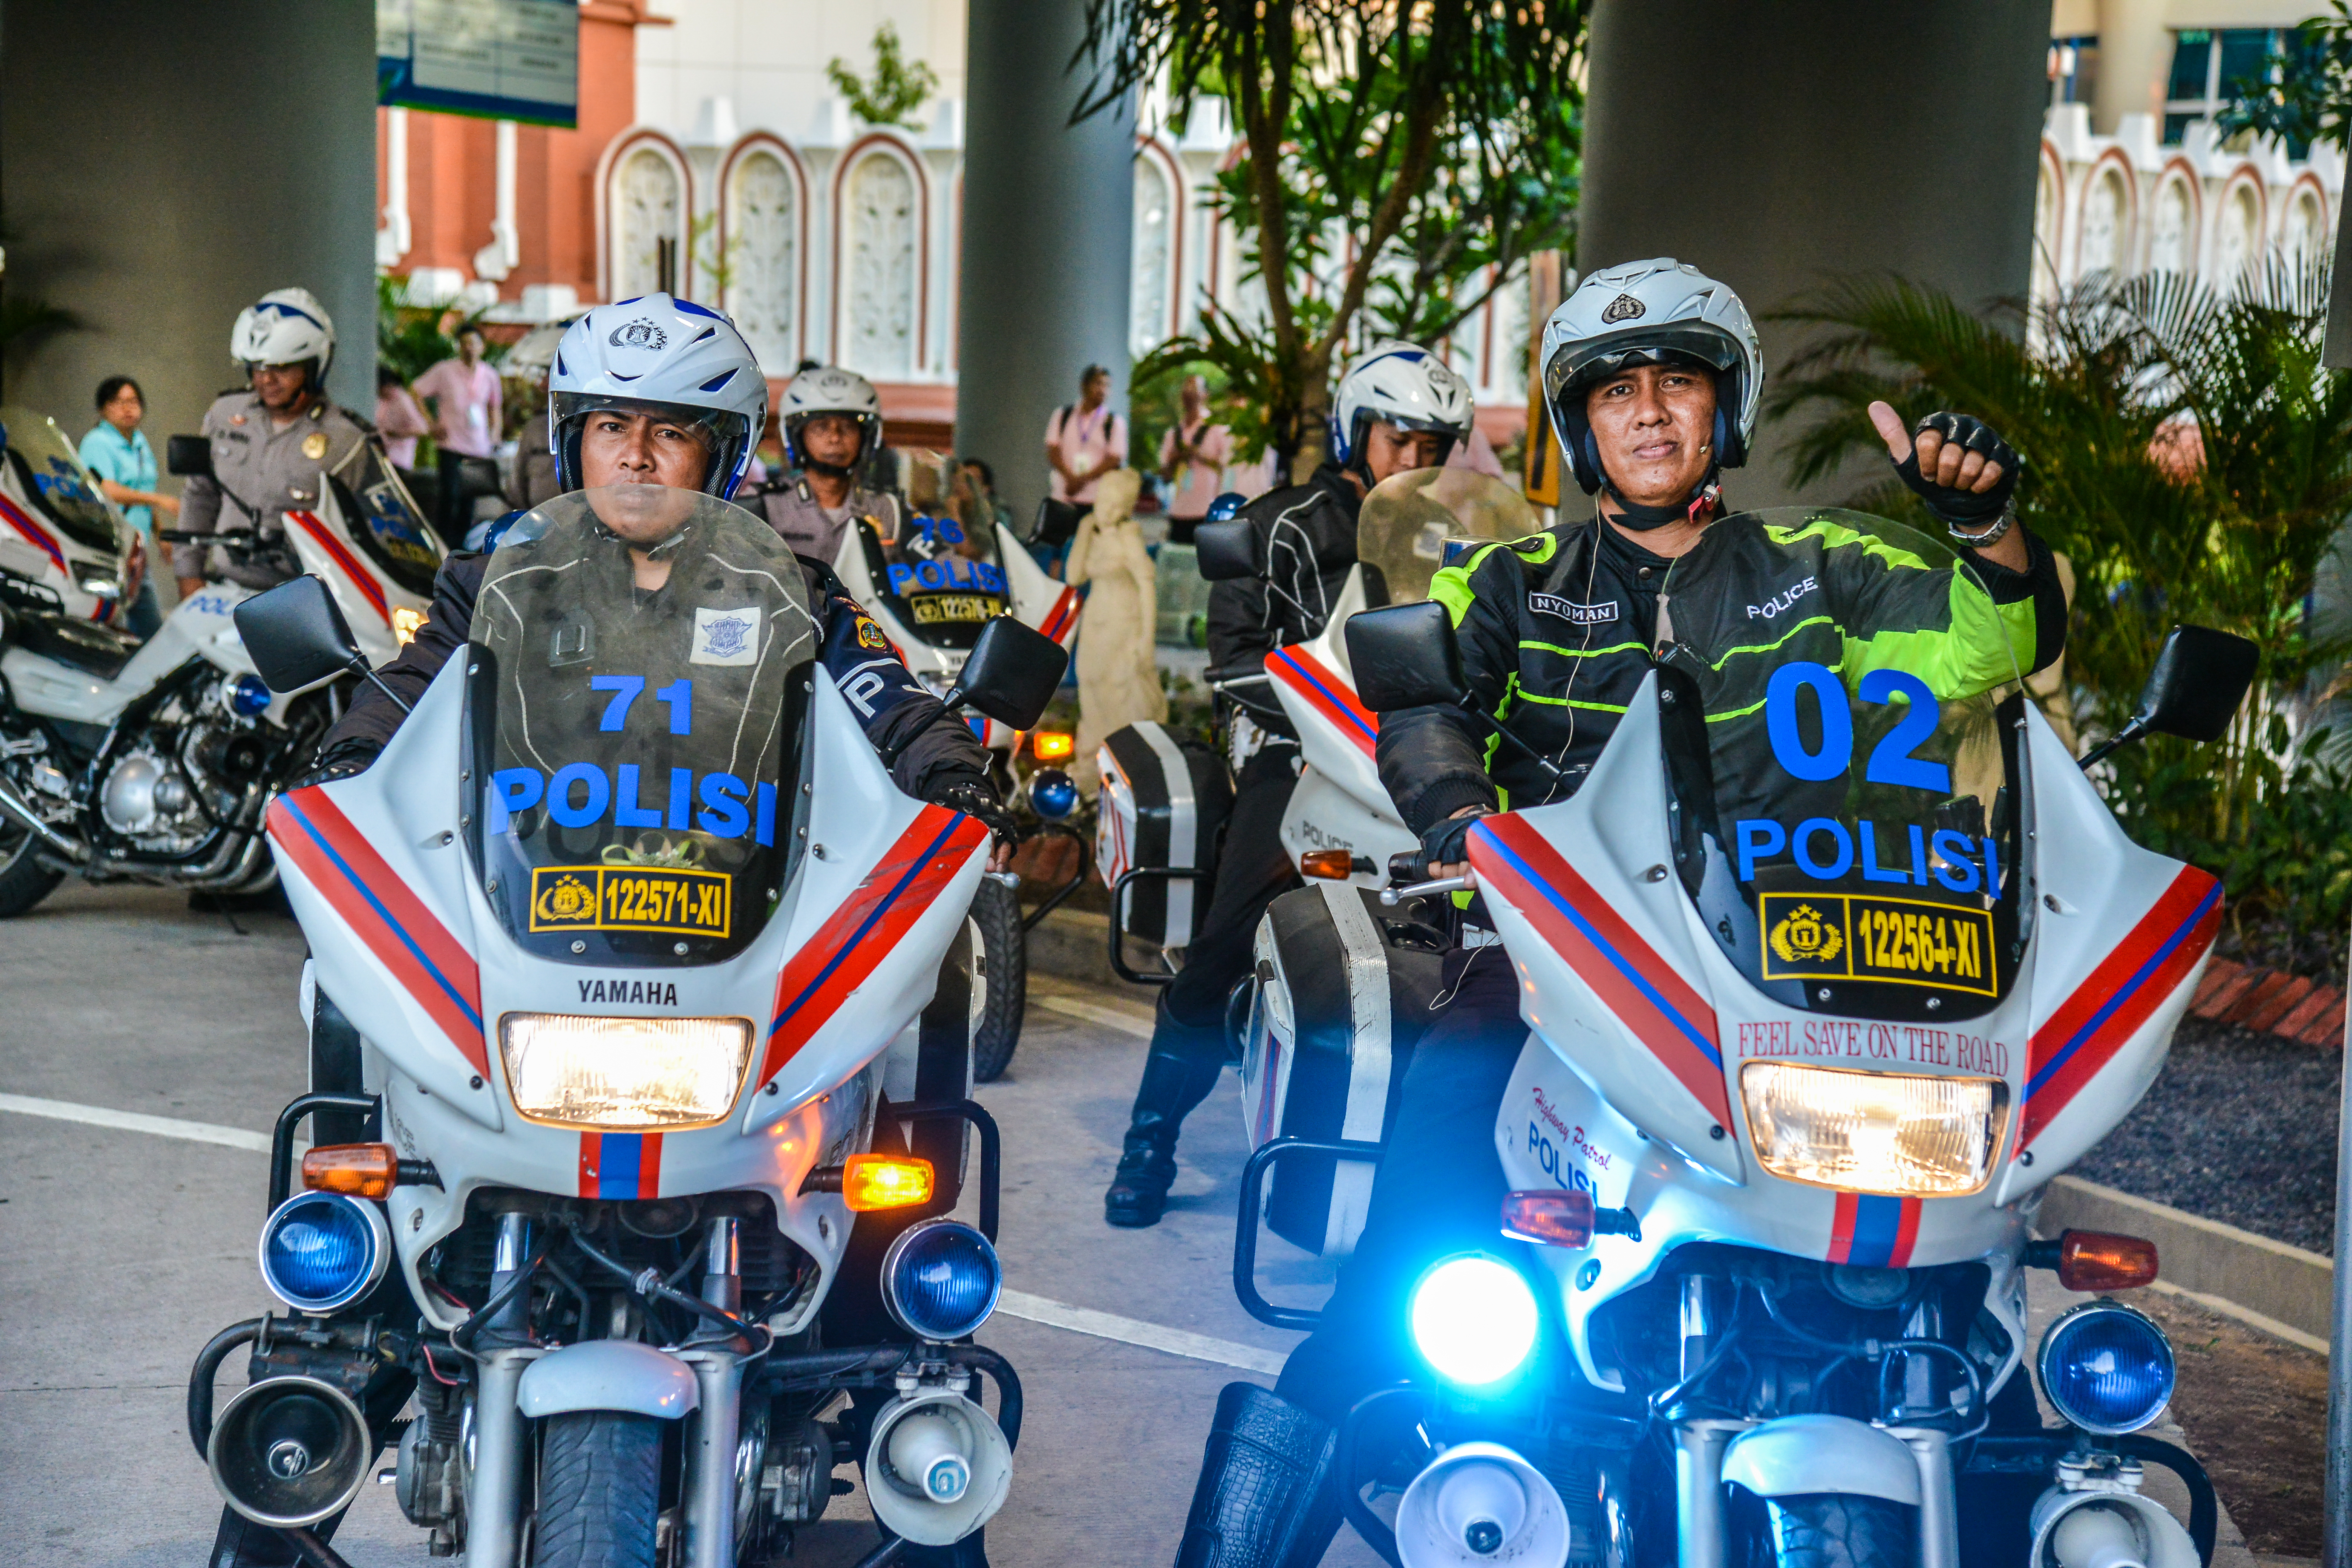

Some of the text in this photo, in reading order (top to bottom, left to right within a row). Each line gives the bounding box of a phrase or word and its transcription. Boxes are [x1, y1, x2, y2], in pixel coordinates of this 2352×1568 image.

[911, 517, 965, 544] 76
[886, 559, 1010, 595] POLISI
[1747, 576, 1819, 619] POLICE
[1537, 597, 1610, 620] NYOMAN
[591, 675, 692, 736] 71
[1766, 661, 1951, 794] 02
[491, 762, 778, 848] POLISI
[1736, 817, 2002, 901] POLISI
[606, 878, 722, 926] 122571-XI
[578, 980, 678, 1006] YAMAHA
[1738, 1021, 2009, 1078] FEEL SAVE ON THE ROAD
[1533, 1087, 1612, 1170] Highway Patrol
[1529, 1120, 1599, 1207] POLISI
